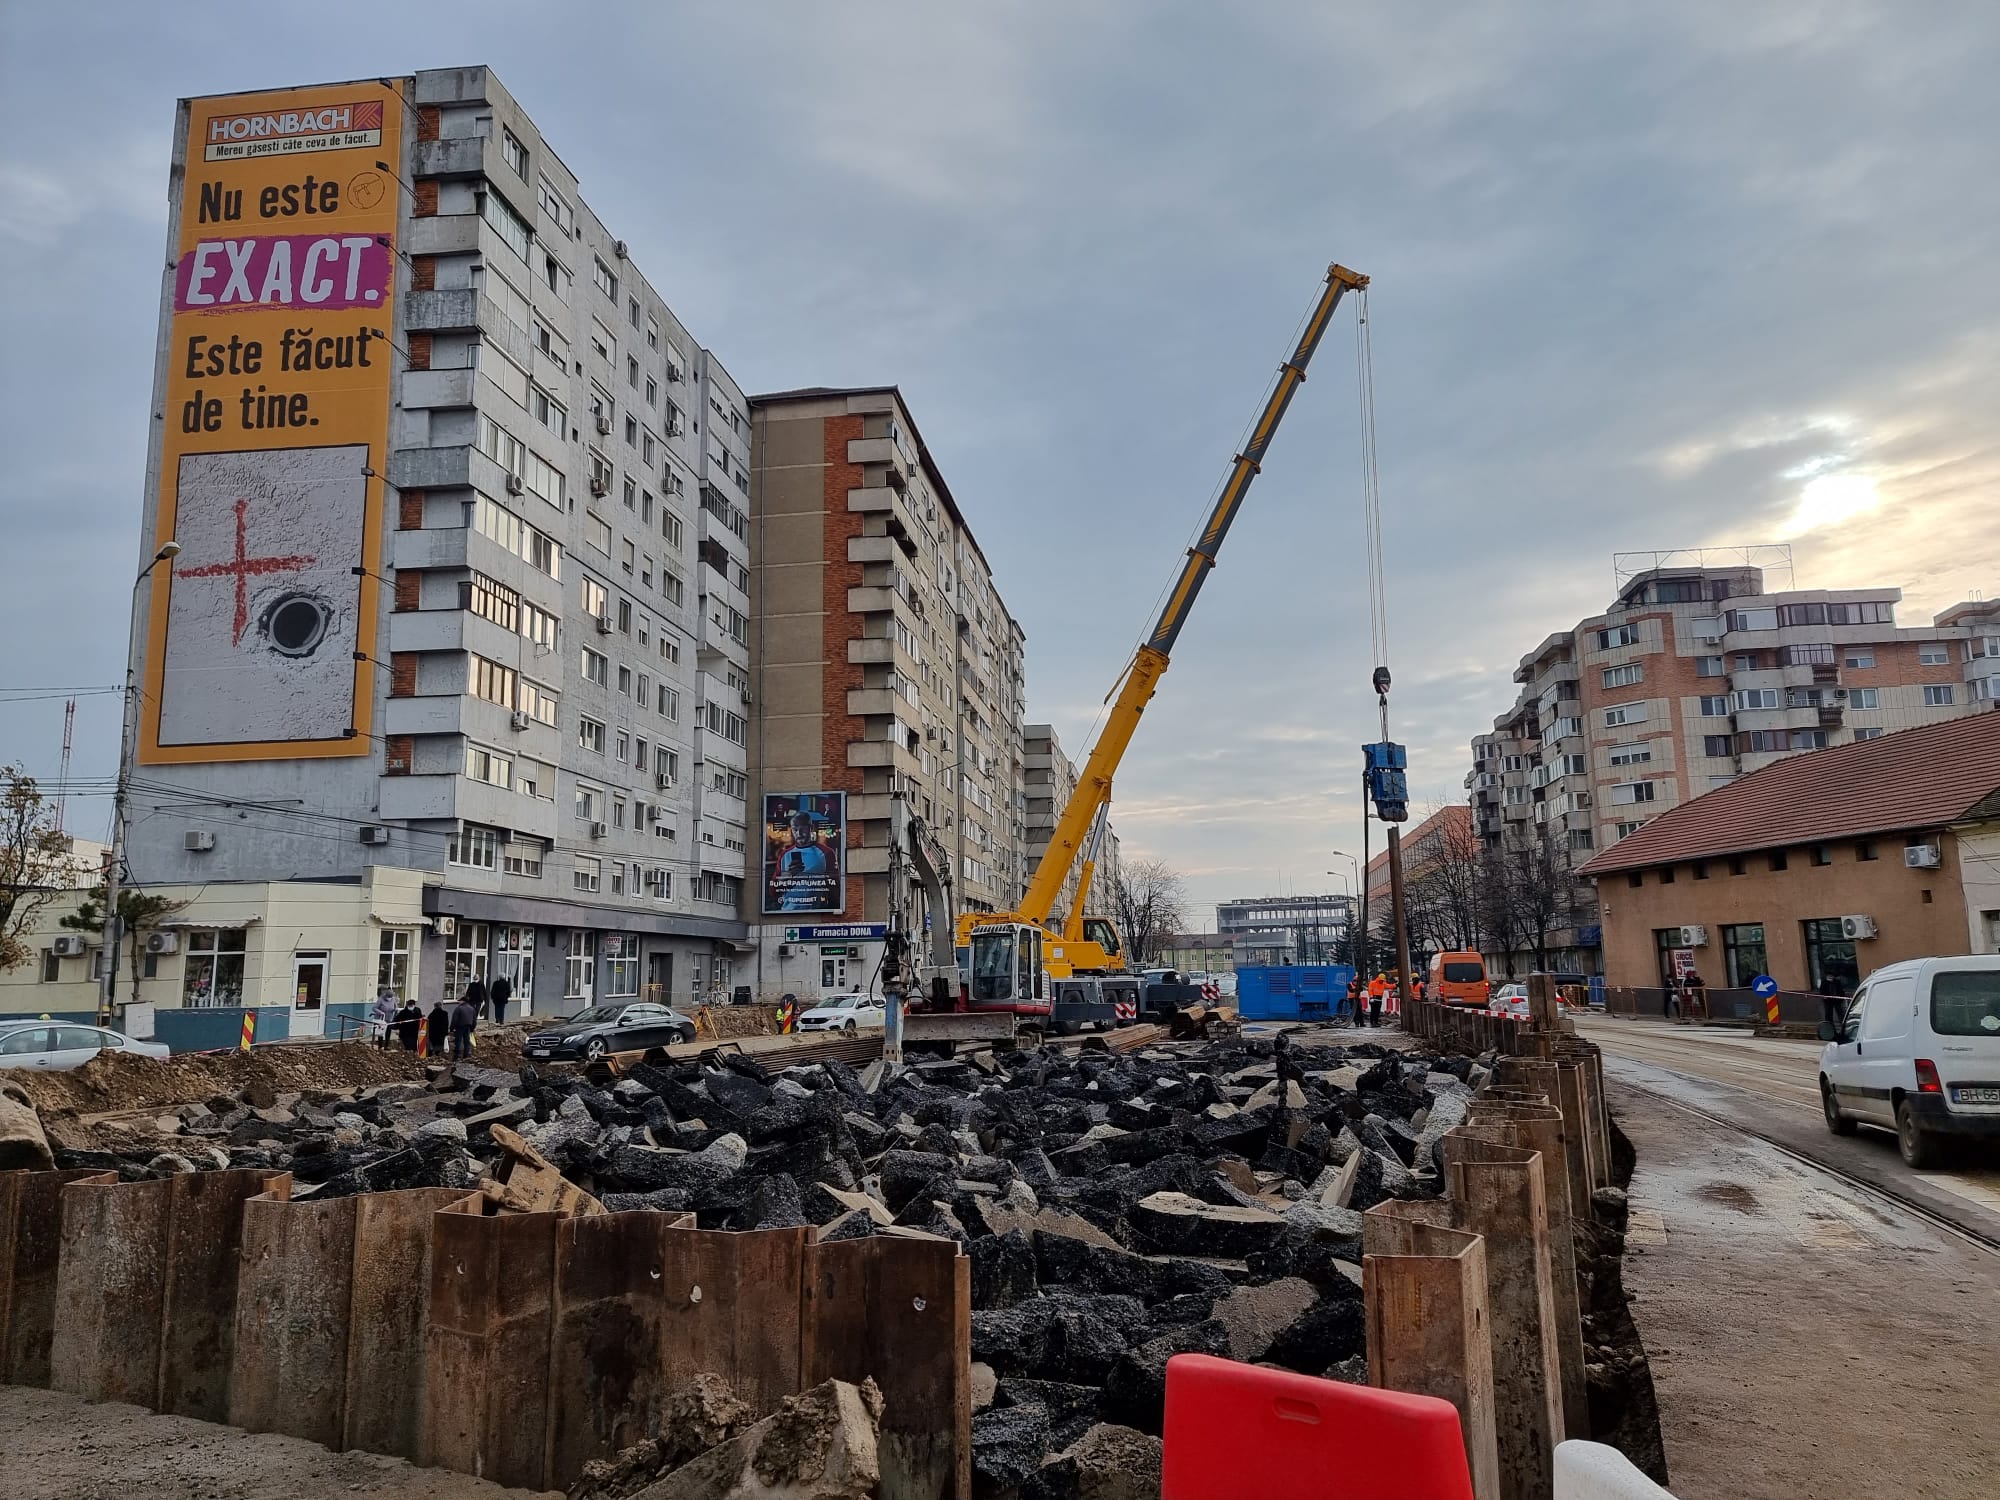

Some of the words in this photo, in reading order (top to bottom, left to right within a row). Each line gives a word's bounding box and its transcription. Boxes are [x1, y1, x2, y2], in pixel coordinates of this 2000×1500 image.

[211, 108, 350, 141] HORNBACH
[216, 145, 244, 157] Mereu
[305, 137, 326, 148] ceva
[329, 134, 341, 146] de
[198, 181, 243, 224] Nu
[259, 175, 339, 219] este
[185, 237, 380, 305] EXACT.
[185, 334, 263, 379] Este
[280, 327, 373, 372] făcut
[182, 389, 223, 434] de
[240, 385, 320, 430] tine.
[813, 928, 848, 936] Farmacia
[850, 927, 871, 936] DONA
[1960, 1090, 1978, 1100] BH
[1983, 1090, 2000, 1100] 65
